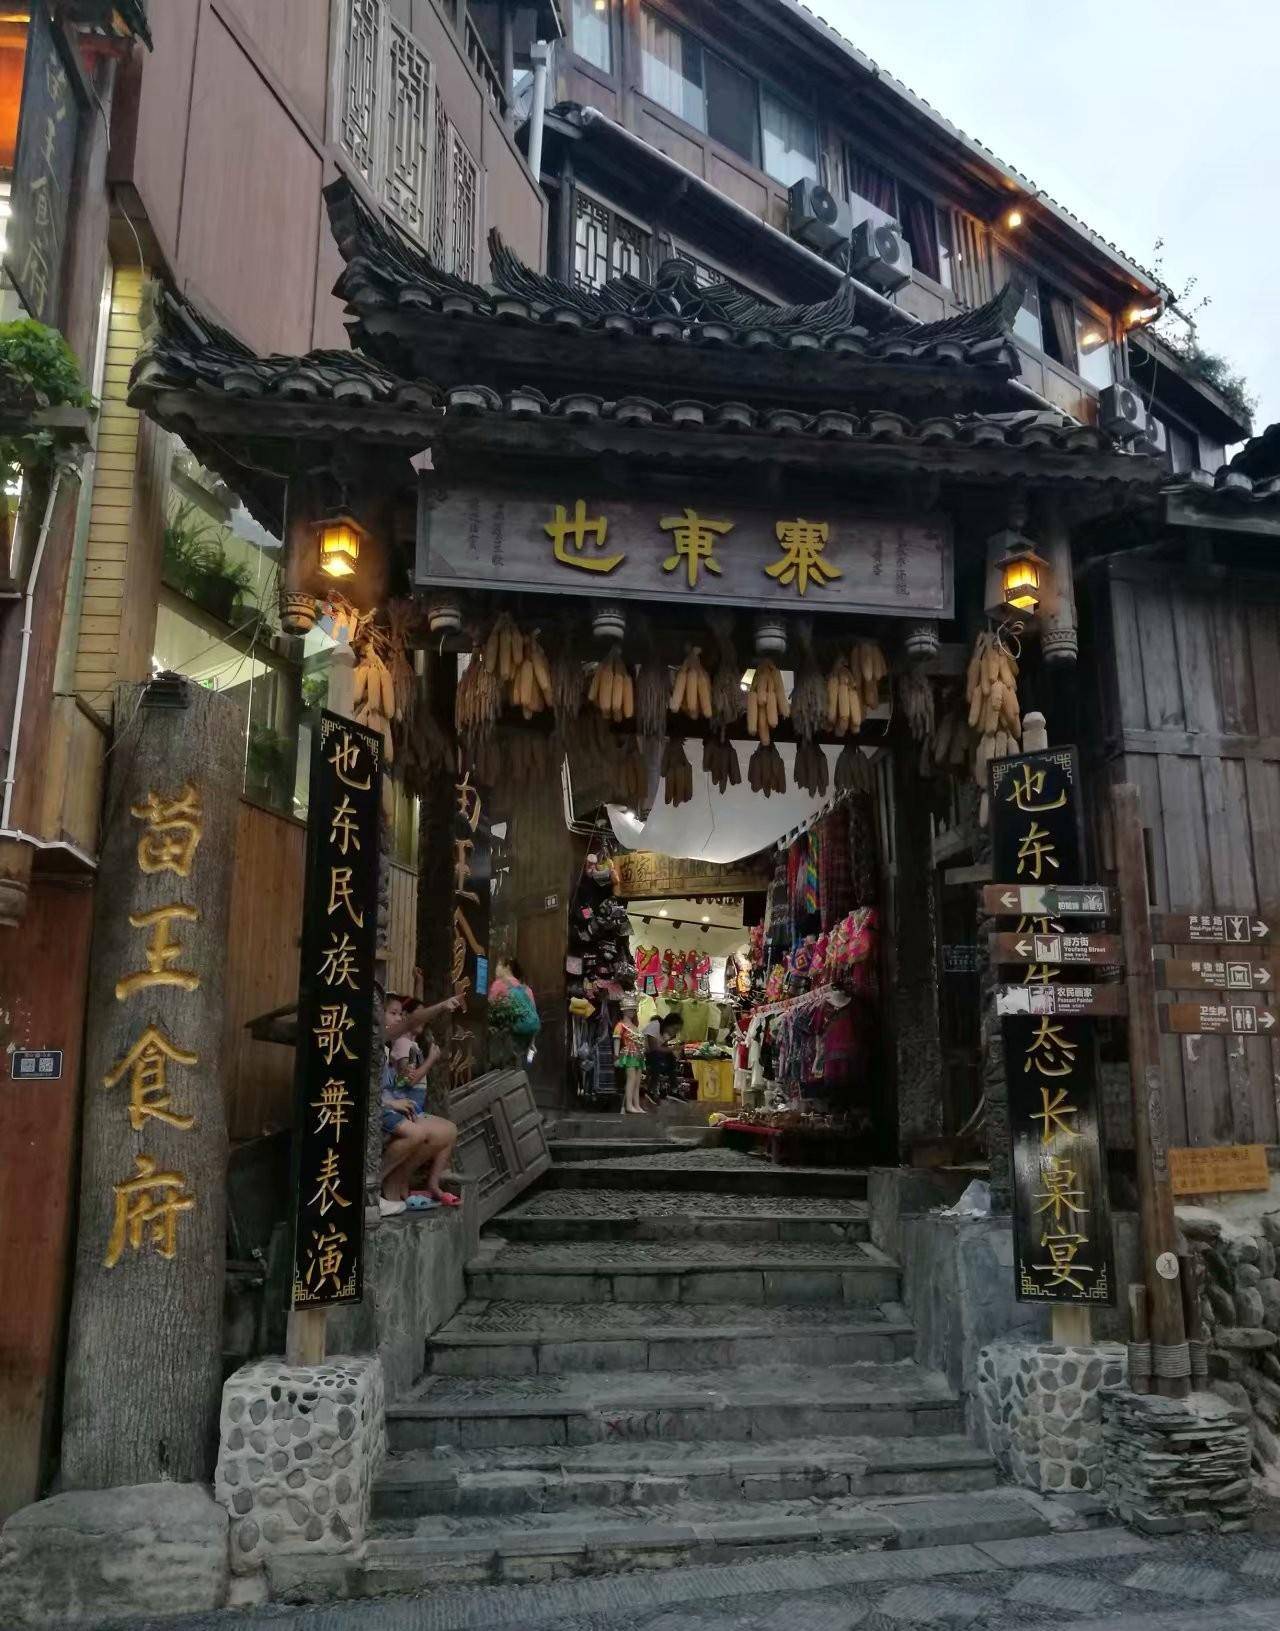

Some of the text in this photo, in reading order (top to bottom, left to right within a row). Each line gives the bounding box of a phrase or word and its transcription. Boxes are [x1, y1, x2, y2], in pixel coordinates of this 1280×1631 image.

[1063, 937, 1089, 947] 游方街
[1057, 987, 1092, 997] 农民画家
[305, 731, 371, 1294] 也东民族歌舞表演
[1200, 1006, 1226, 1016] 卫生间
